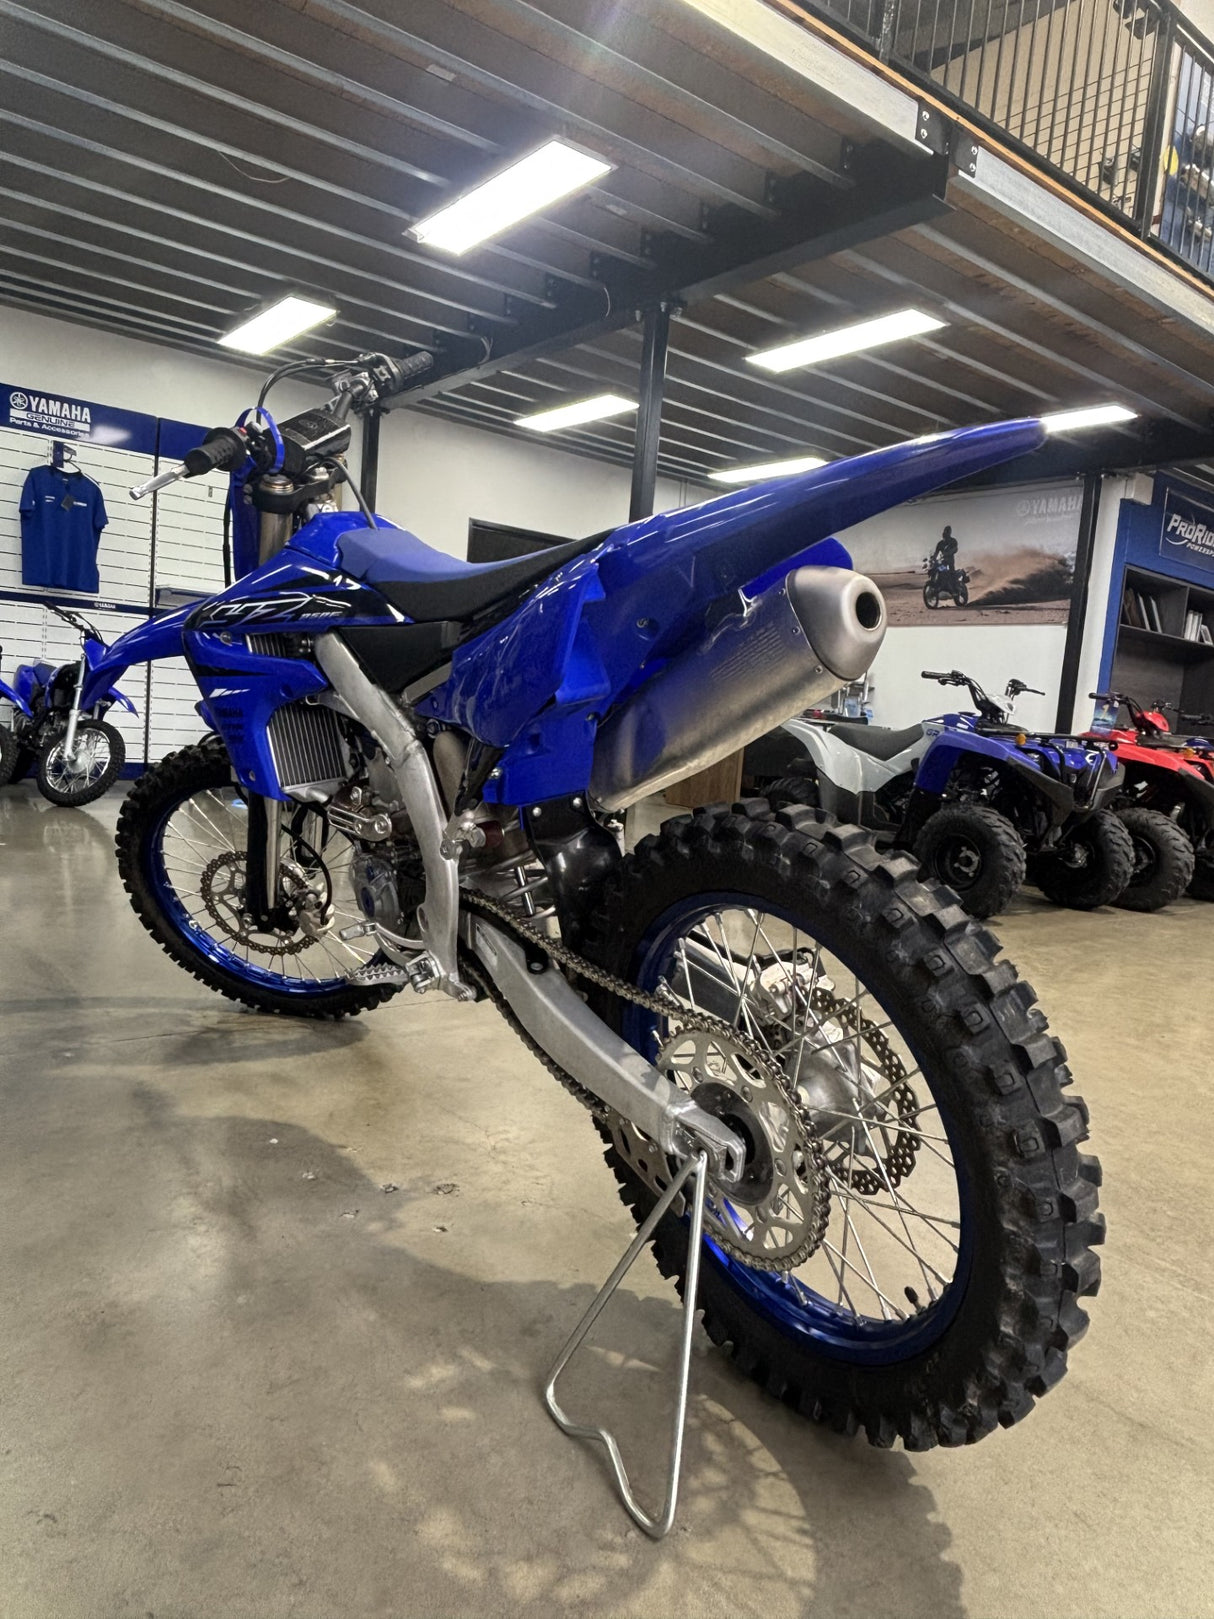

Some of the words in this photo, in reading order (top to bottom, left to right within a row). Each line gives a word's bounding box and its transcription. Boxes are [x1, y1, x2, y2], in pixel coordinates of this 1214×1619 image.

[26, 412, 76, 428] GENUINE
[29, 395, 91, 423] YAMAHA
[9, 417, 32, 427] Parts
[41, 424, 90, 439] Accessories
